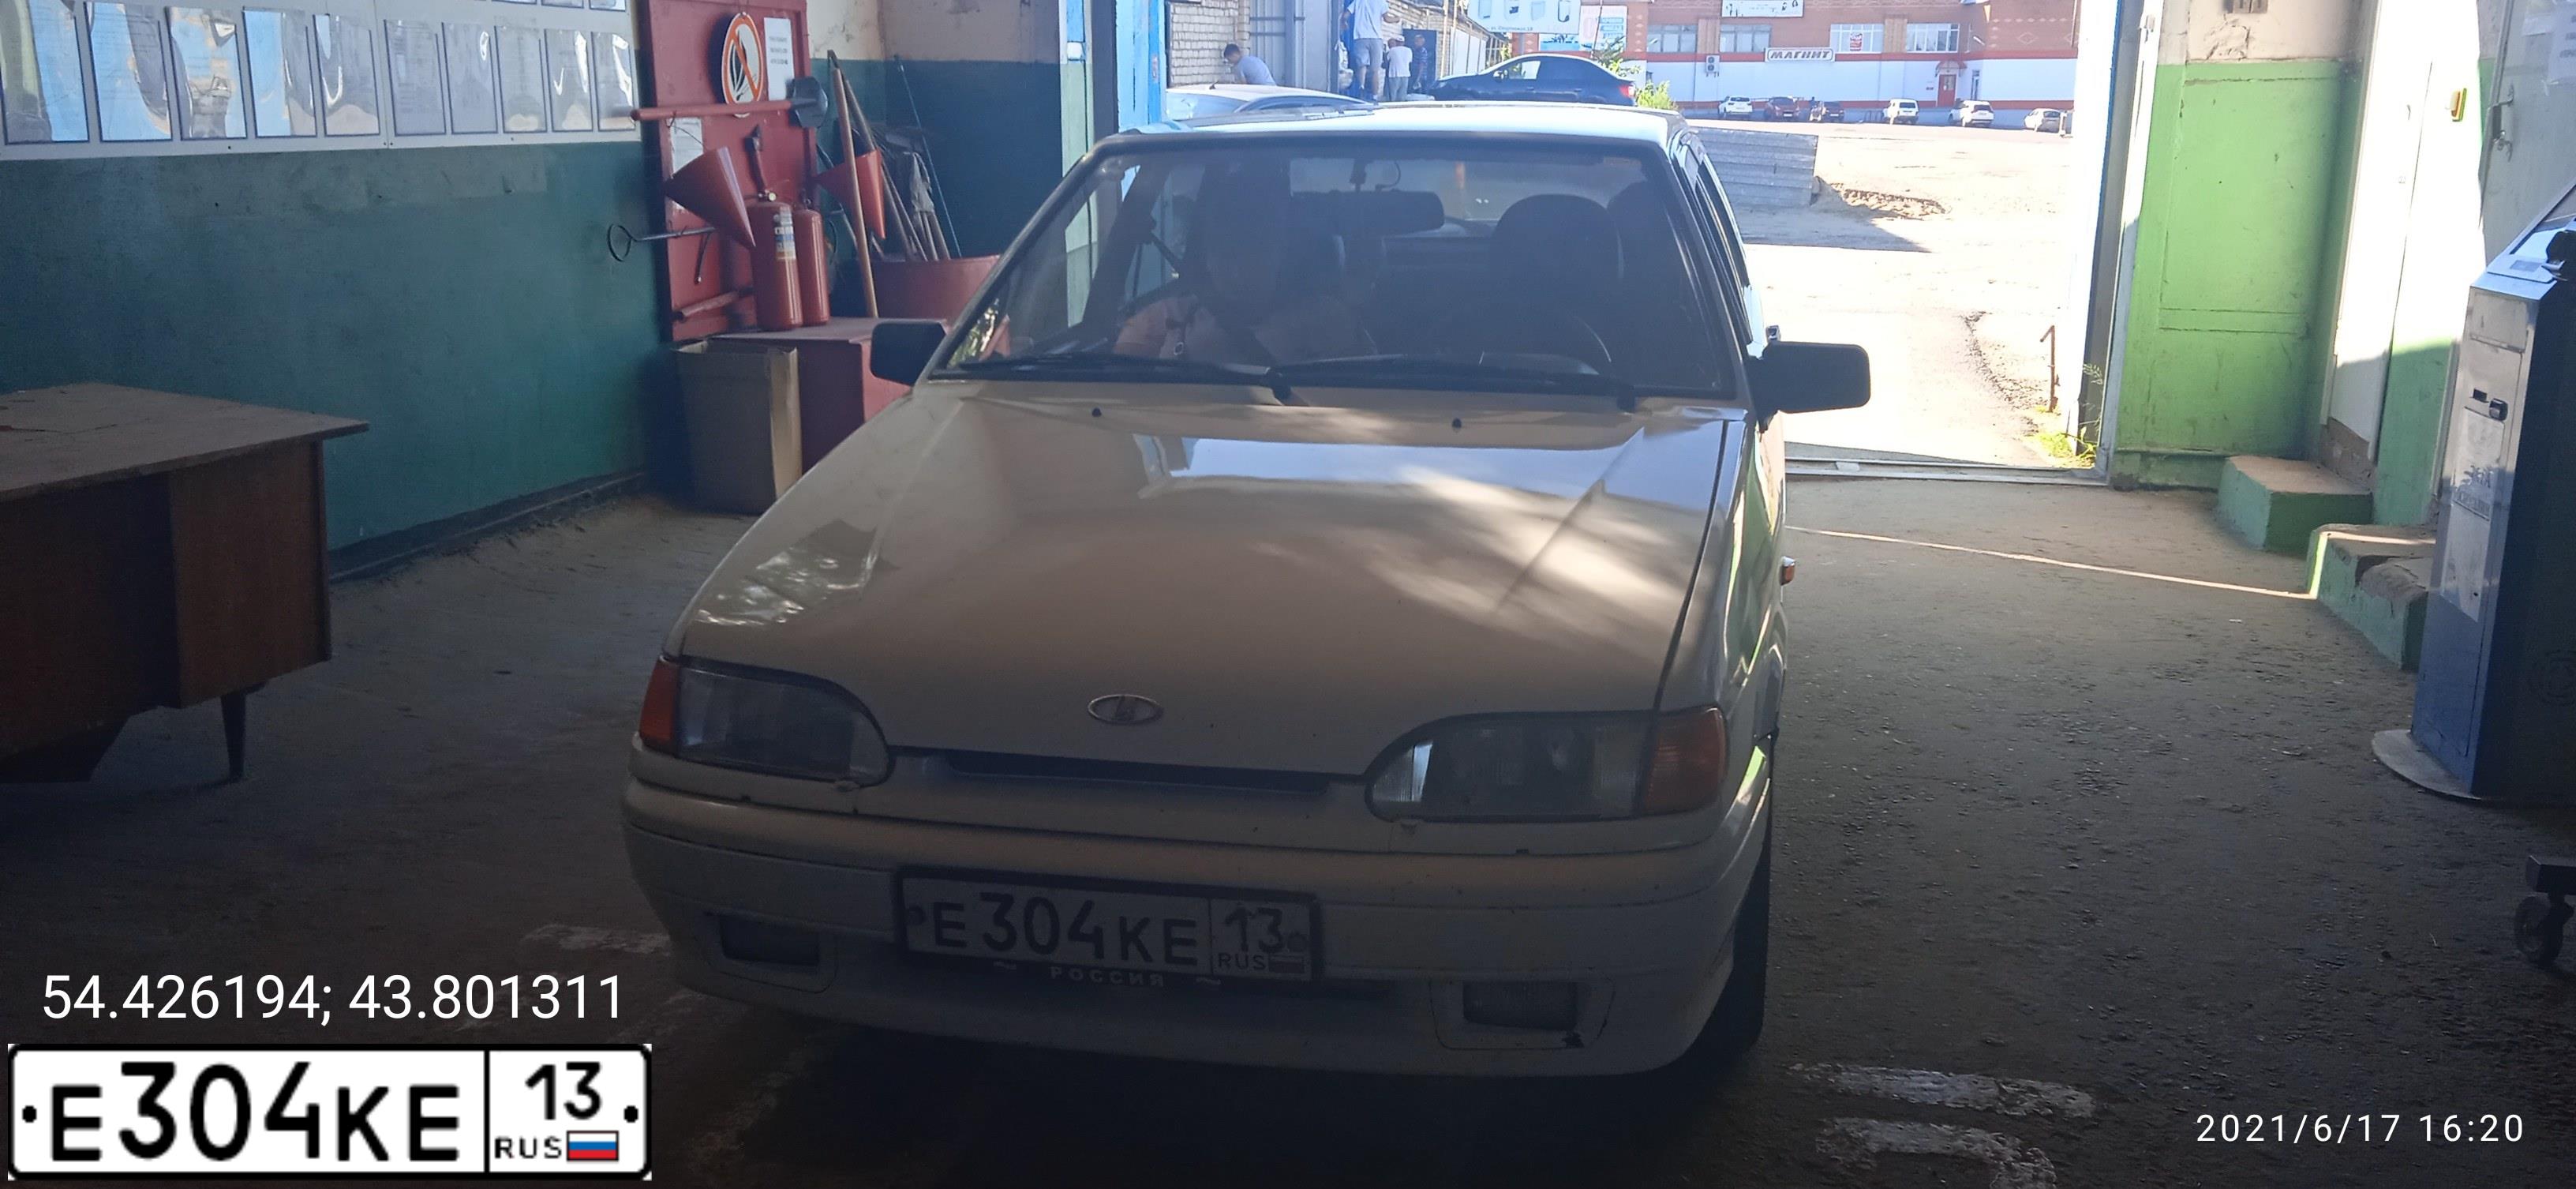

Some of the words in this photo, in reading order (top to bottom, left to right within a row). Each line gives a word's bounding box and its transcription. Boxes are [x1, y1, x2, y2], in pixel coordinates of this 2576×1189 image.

[1770, 51, 1829, 59] МАГНИТ
[1225, 906, 1283, 954] 13
[1218, 952, 1266, 970] RUS
[1050, 966, 1164, 987] РОССИЯ
